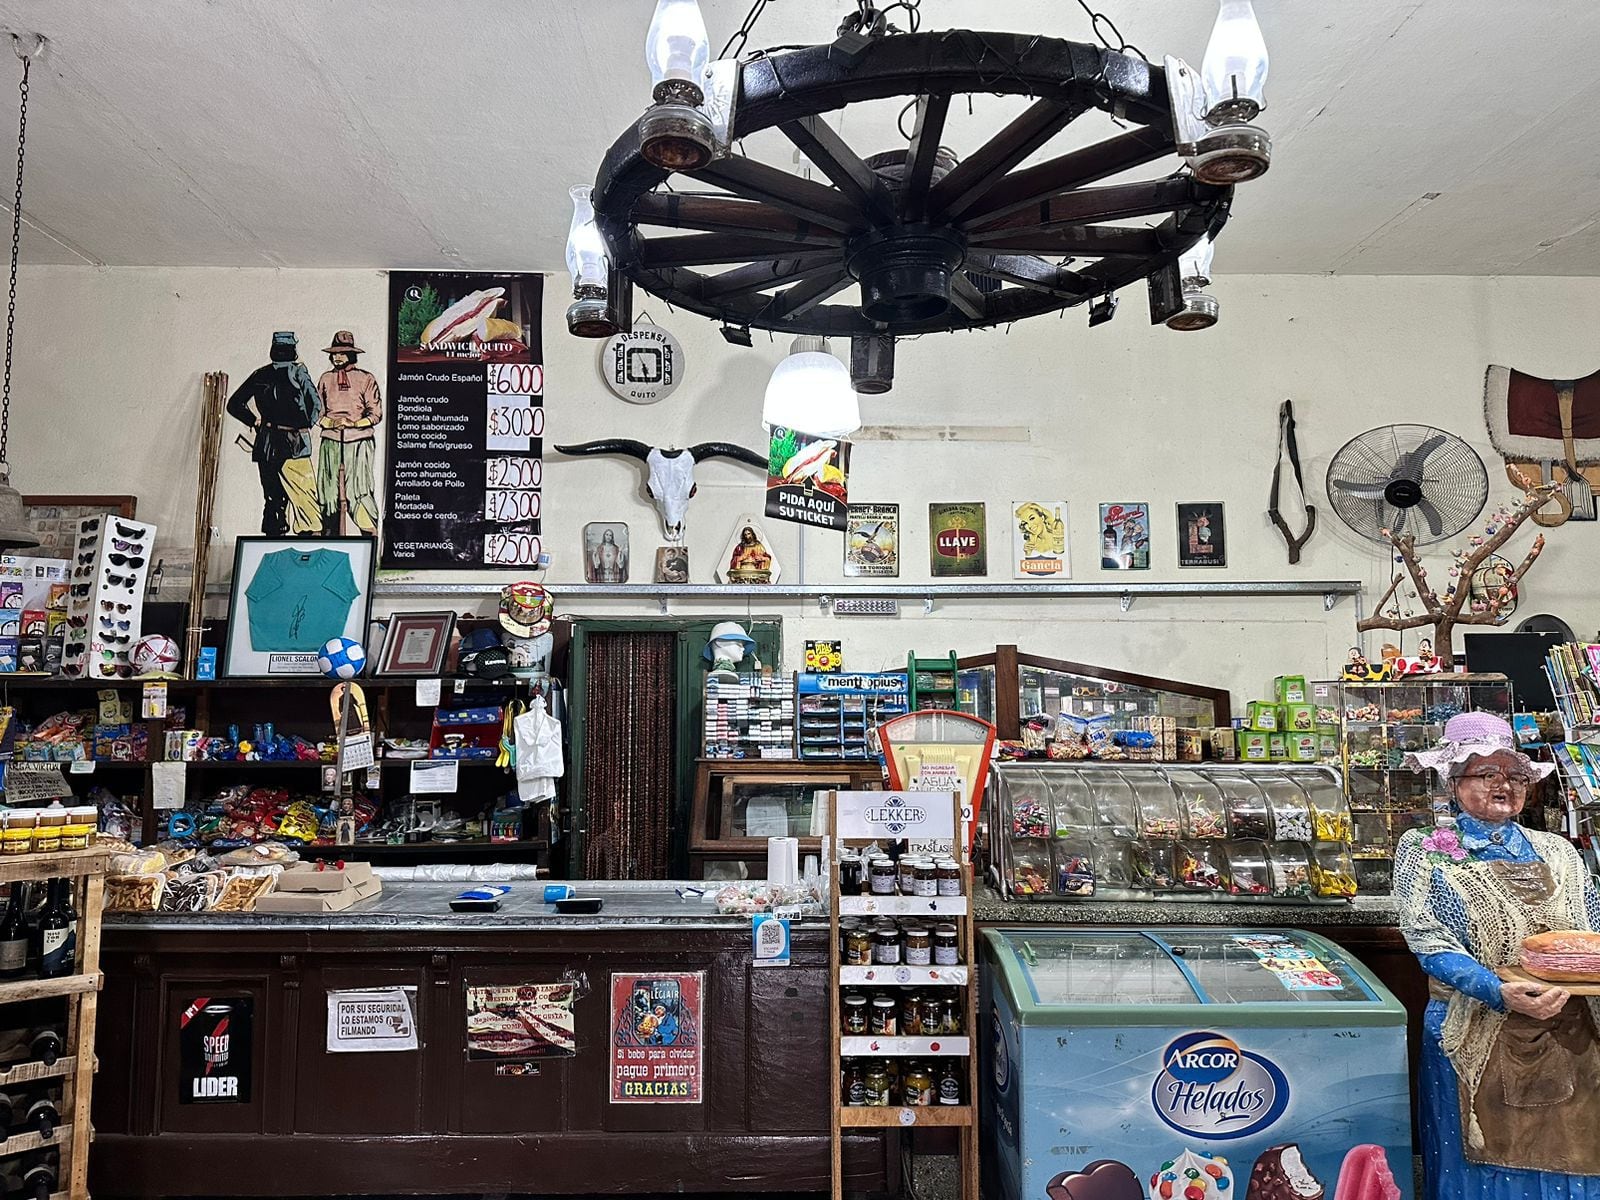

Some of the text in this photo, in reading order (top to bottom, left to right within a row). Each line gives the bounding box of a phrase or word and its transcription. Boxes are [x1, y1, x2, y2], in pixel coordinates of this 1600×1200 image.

[621, 331, 667, 344] DESPENSA
[480, 342, 513, 352] QUITO
[398, 373, 483, 383] Jamón Crudo Español
[488, 363, 544, 394] $6000
[630, 390, 656, 398] QUITO
[398, 395, 449, 404] Jamón crudo
[398, 405, 432, 413] Bondiola
[398, 414, 469, 422] Panceta ahumada
[489, 406, 545, 437] $3000
[397, 423, 465, 431] Lomo saborizado
[397, 432, 447, 440] Lomo cocido
[397, 441, 473, 450] Salame fino/grueso
[396, 461, 450, 469] Jamón cocido
[488, 457, 543, 488] $2500
[395, 480, 430, 488] Arrollado
[445, 480, 465, 488] Pollo
[395, 493, 420, 501] Paleta
[395, 502, 434, 510] Mortadela
[488, 491, 541, 522] $2300
[779, 492, 836, 513] PIDA AQUÍ
[394, 512, 458, 520] Queso de cerdo
[779, 505, 835, 526] SU TICKET
[393, 542, 454, 550] VEGETARIANOS
[939, 536, 976, 547] LLAVE
[486, 534, 541, 566] $2500
[1021, 560, 1062, 571] Gancia
[870, 809, 922, 822] LEKKER
[341, 1004, 355, 1013] POR
[357, 1004, 367, 1013] SU
[341, 1015, 384, 1024] LO ESTAMOS
[341, 1026, 377, 1036] FILMANDO
[203, 1034, 230, 1054] SPEED
[617, 1049, 696, 1061] Si bebe para olvidar
[1166, 1049, 1238, 1069] ARCOR
[616, 1062, 696, 1079] pague primero
[193, 1076, 239, 1097] LIDER
[625, 1081, 688, 1096] GRACIAS
[1168, 1080, 1265, 1115] Helados
